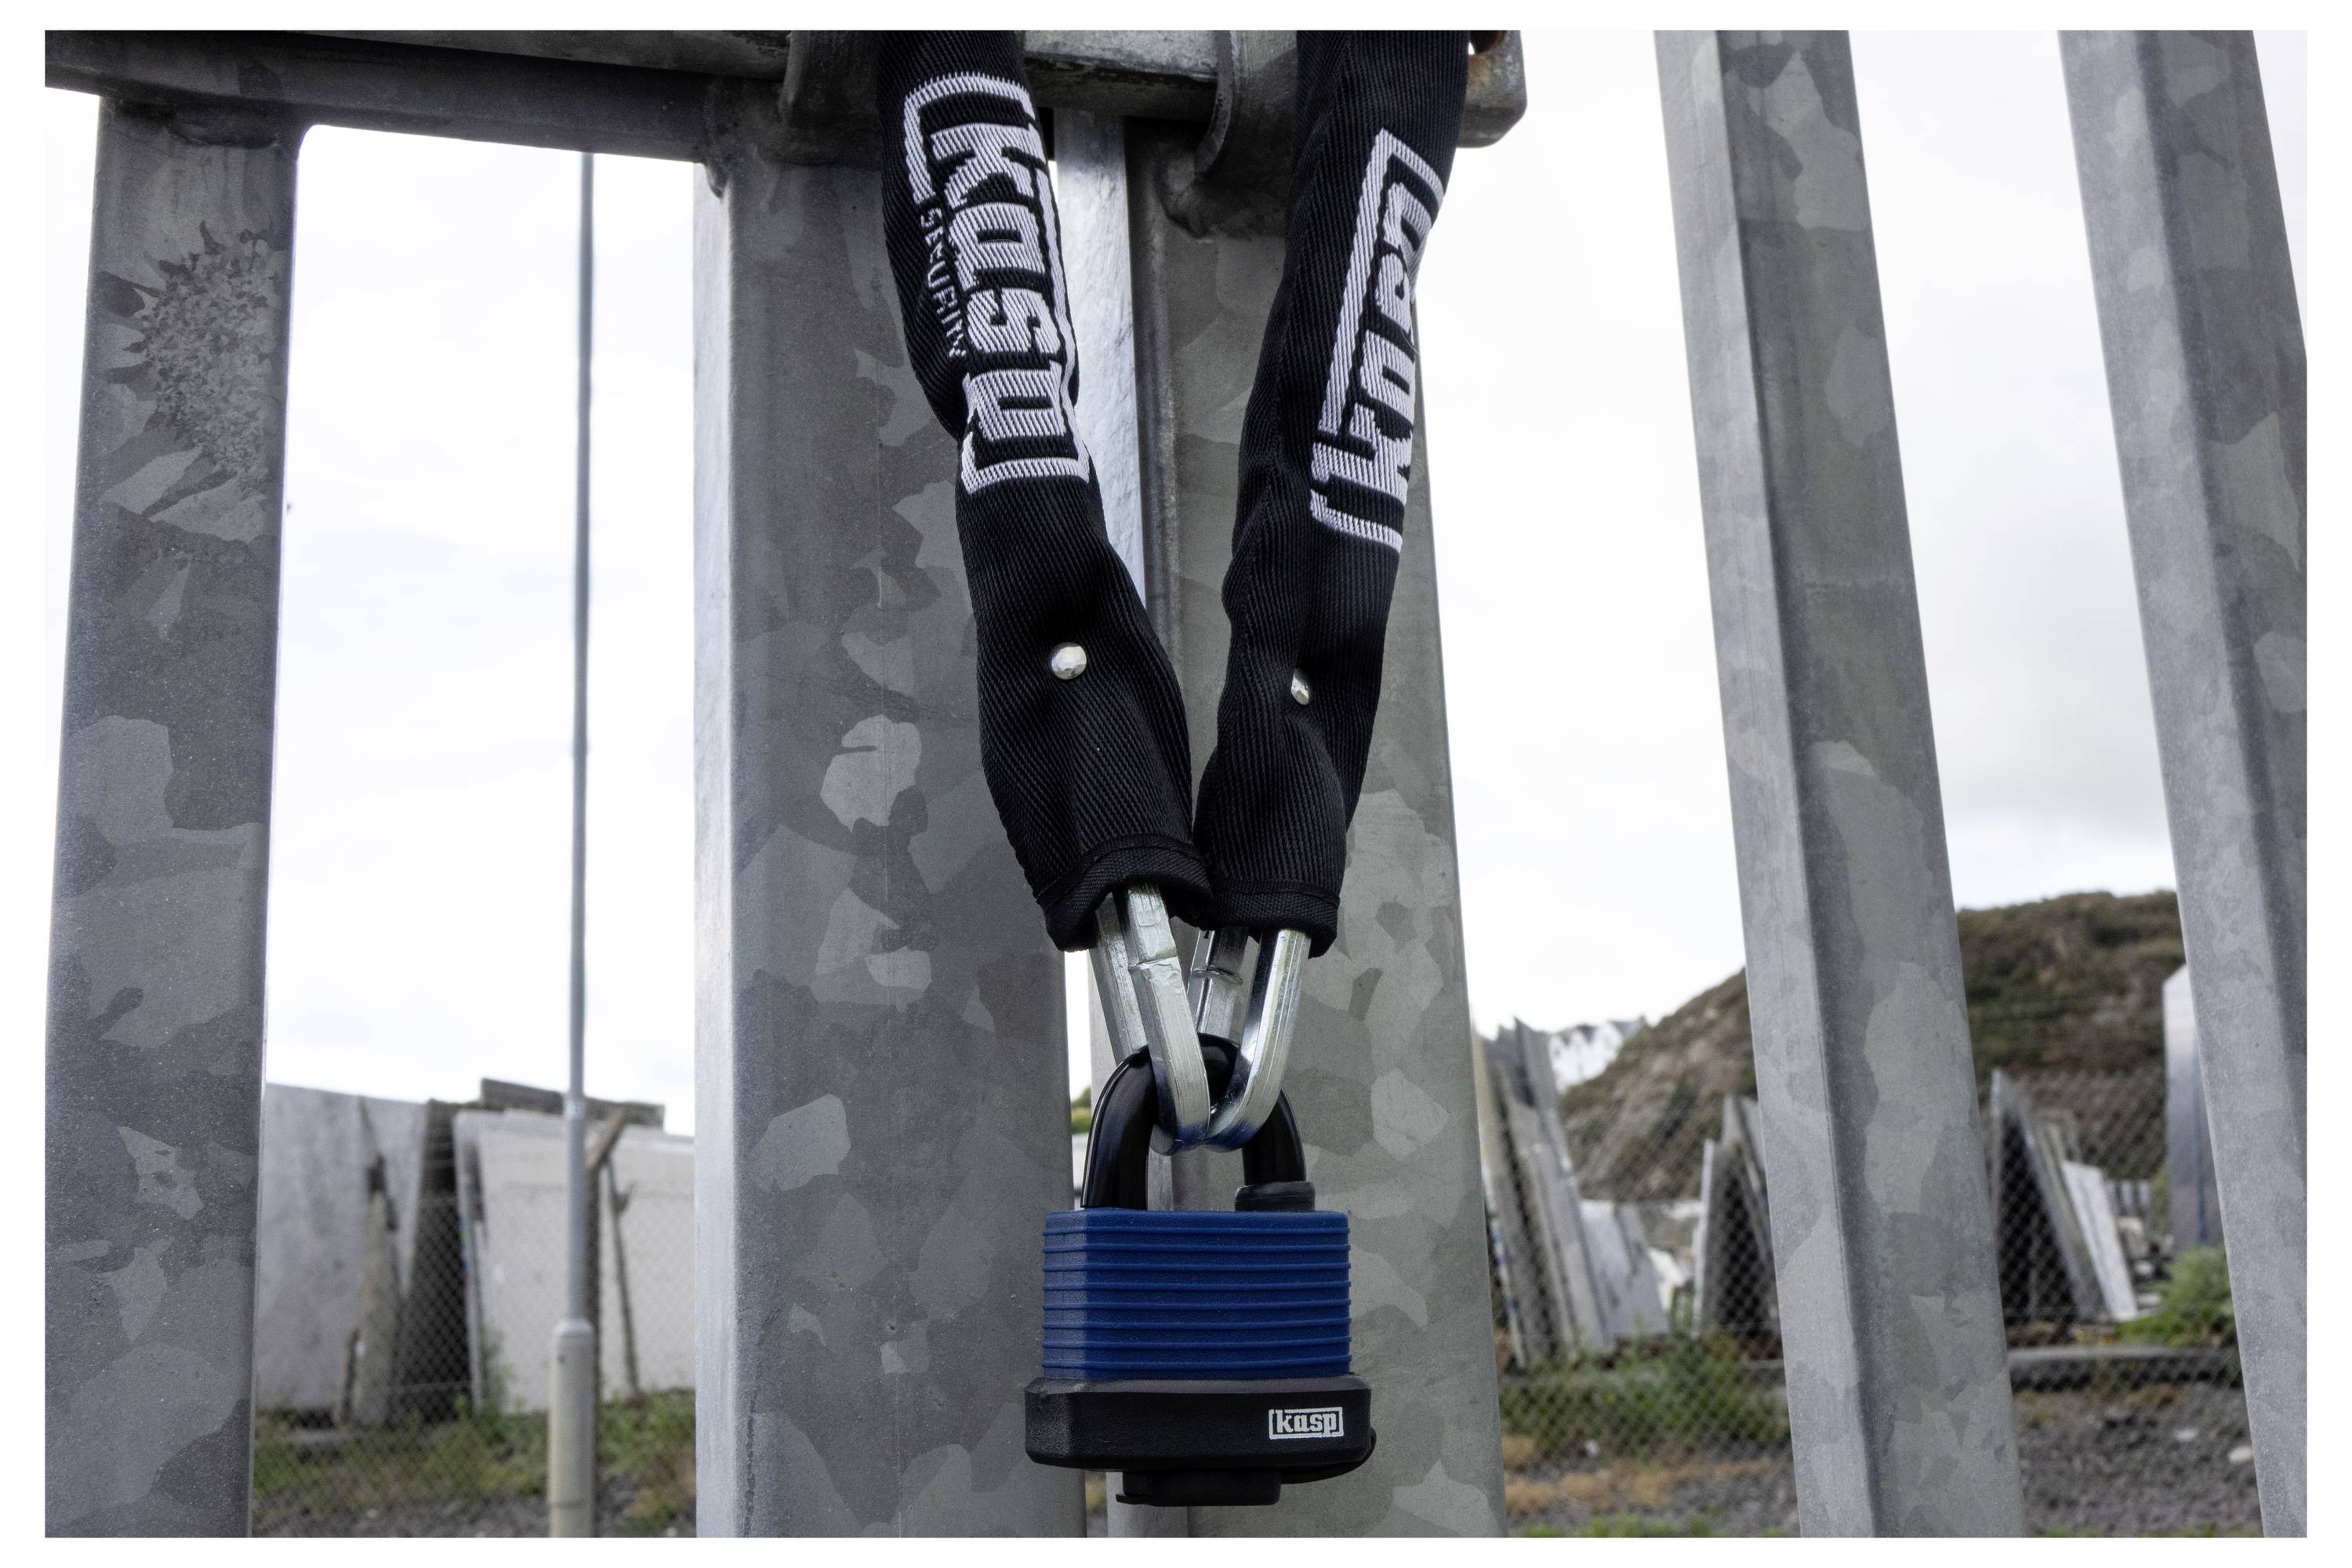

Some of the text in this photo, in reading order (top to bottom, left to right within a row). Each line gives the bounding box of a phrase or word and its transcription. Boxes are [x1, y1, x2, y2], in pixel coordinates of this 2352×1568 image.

[920, 208, 967, 358] SECURITY
[931, 123, 1068, 440] kasp
[1276, 1409, 1338, 1436] kasp
